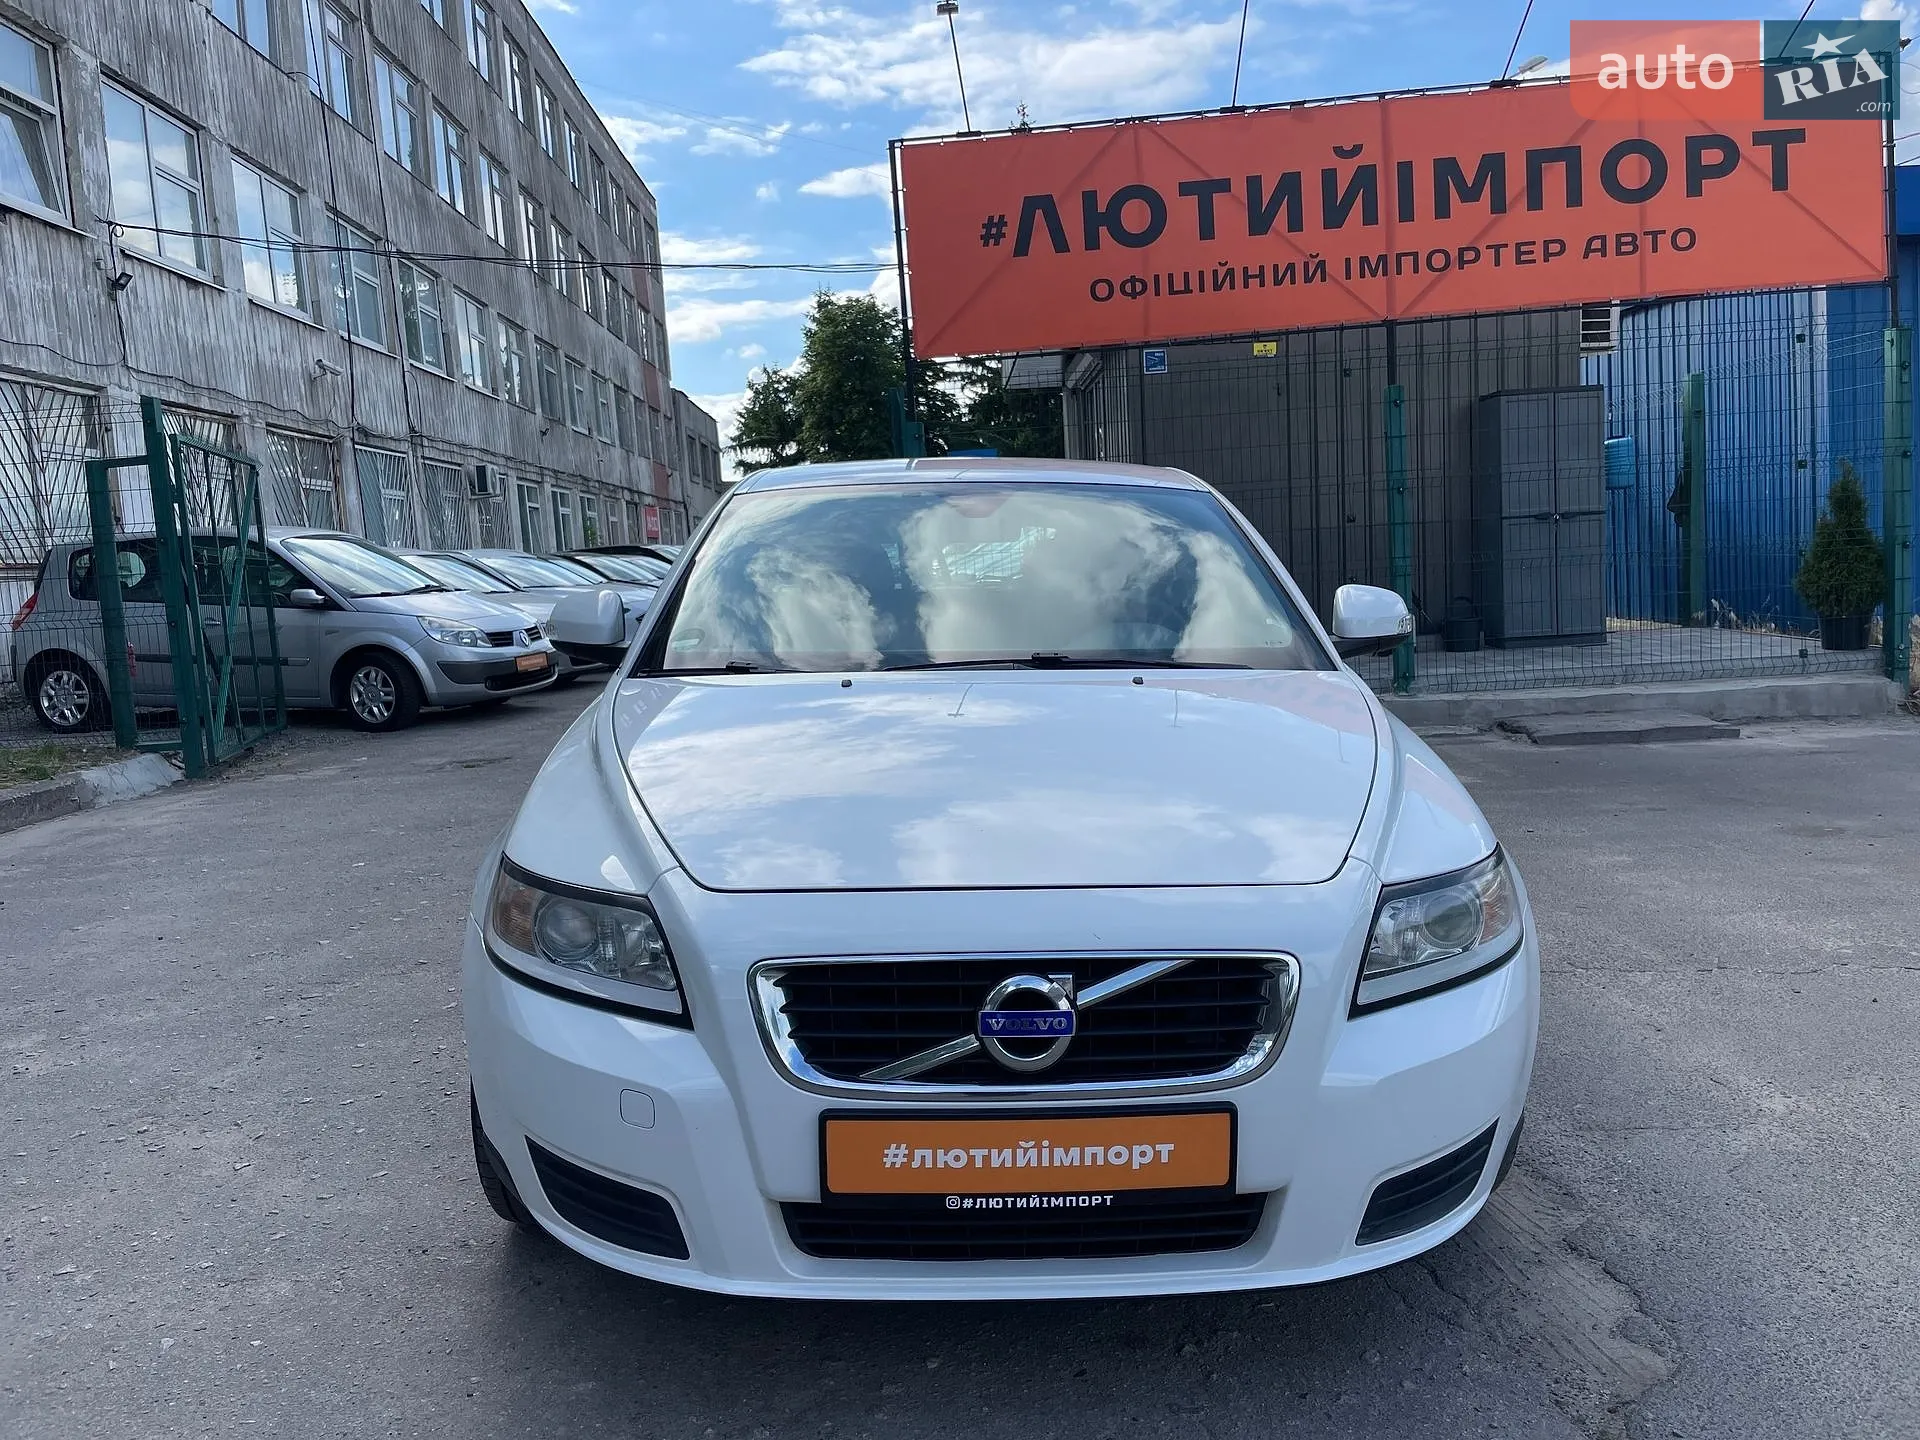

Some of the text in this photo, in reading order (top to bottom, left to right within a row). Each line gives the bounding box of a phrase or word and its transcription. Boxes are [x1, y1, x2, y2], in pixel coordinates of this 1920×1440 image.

[979, 127, 1807, 258] #ЛЮТИЙІМПОРТ
[1089, 226, 1697, 303] ОФІЦІЙНИЙ ІМПОРТЕР АВТО
[985, 1017, 1068, 1031] VOLVO
[882, 1139, 1175, 1170] #лютийімпорт
[962, 1194, 1114, 1209] #ЛЮТИЙІМПОРТ
